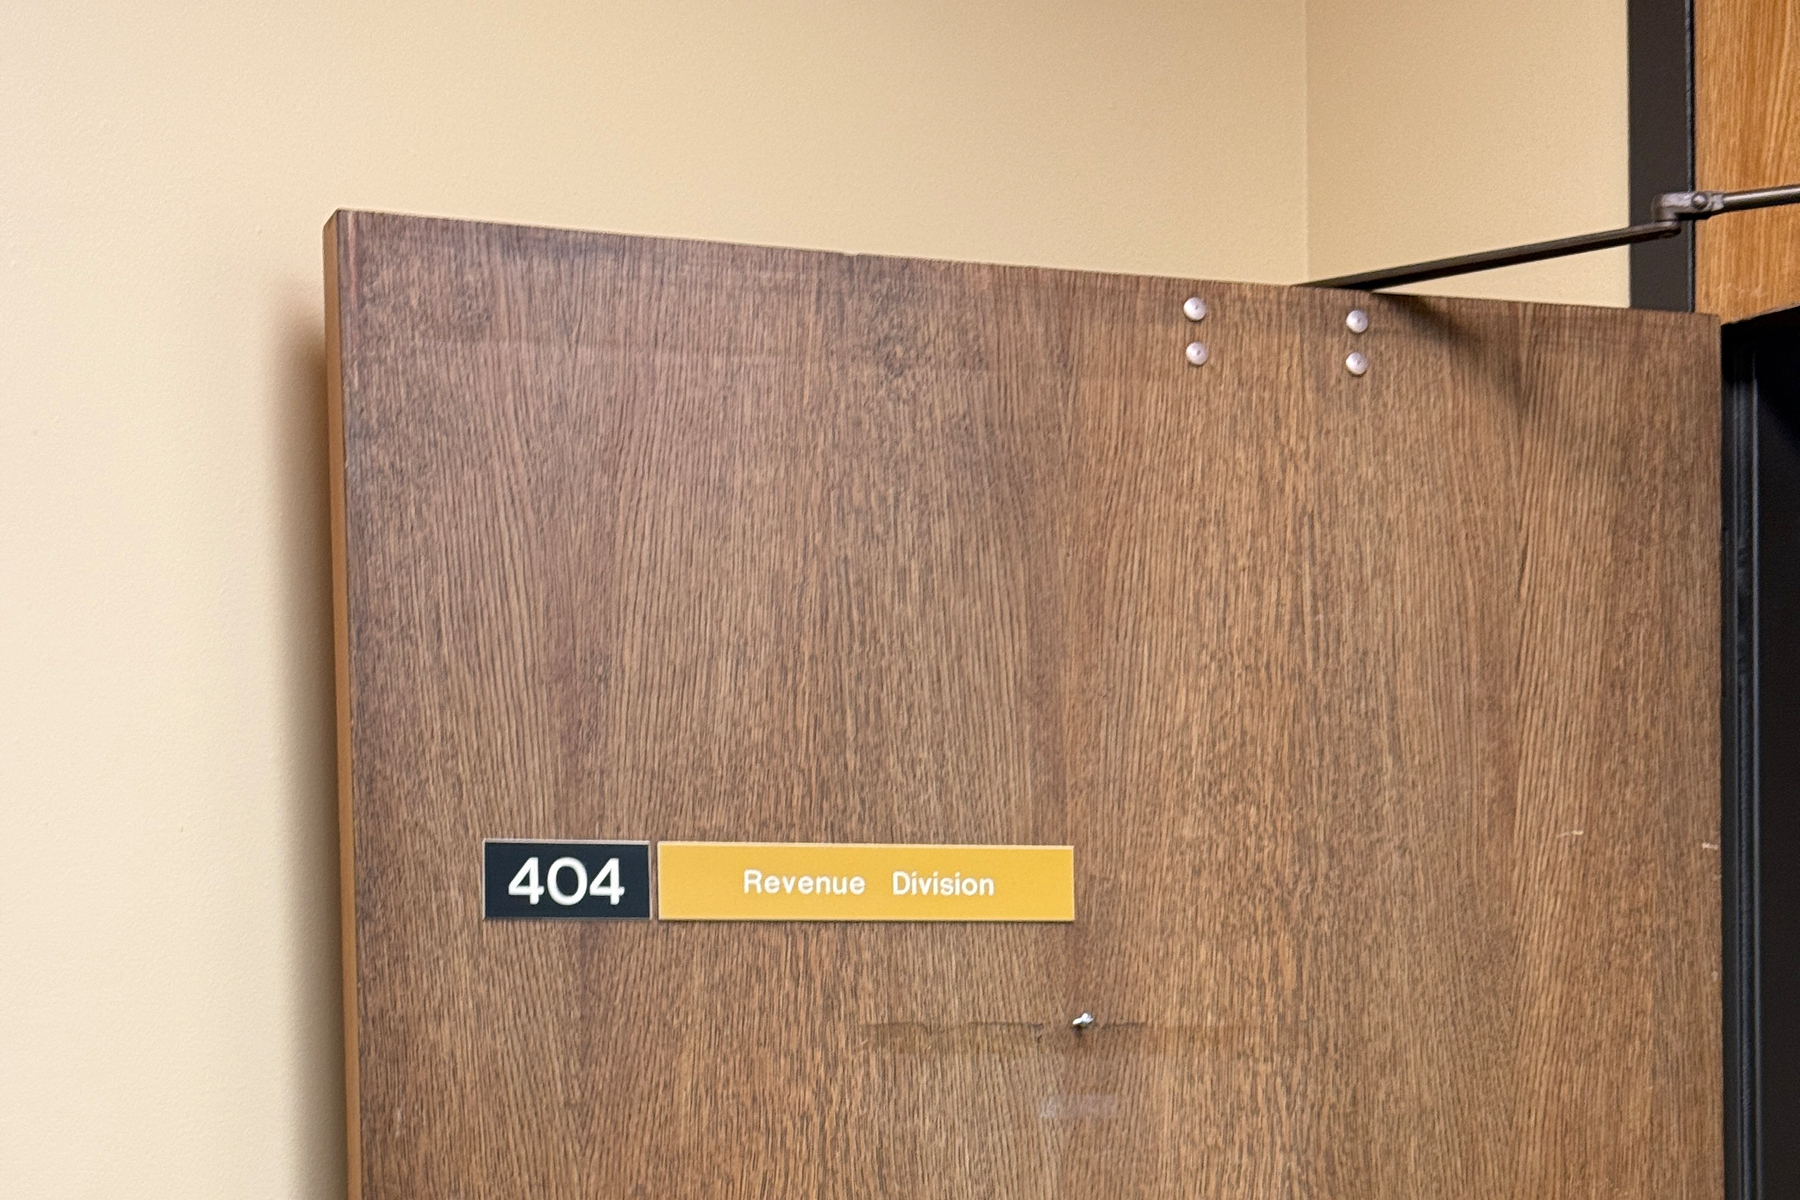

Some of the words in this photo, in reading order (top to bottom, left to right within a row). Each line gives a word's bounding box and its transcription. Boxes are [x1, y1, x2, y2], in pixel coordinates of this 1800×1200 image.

[508, 857, 625, 905] 404
[743, 868, 866, 895] Revenue
[892, 870, 995, 897] Division
